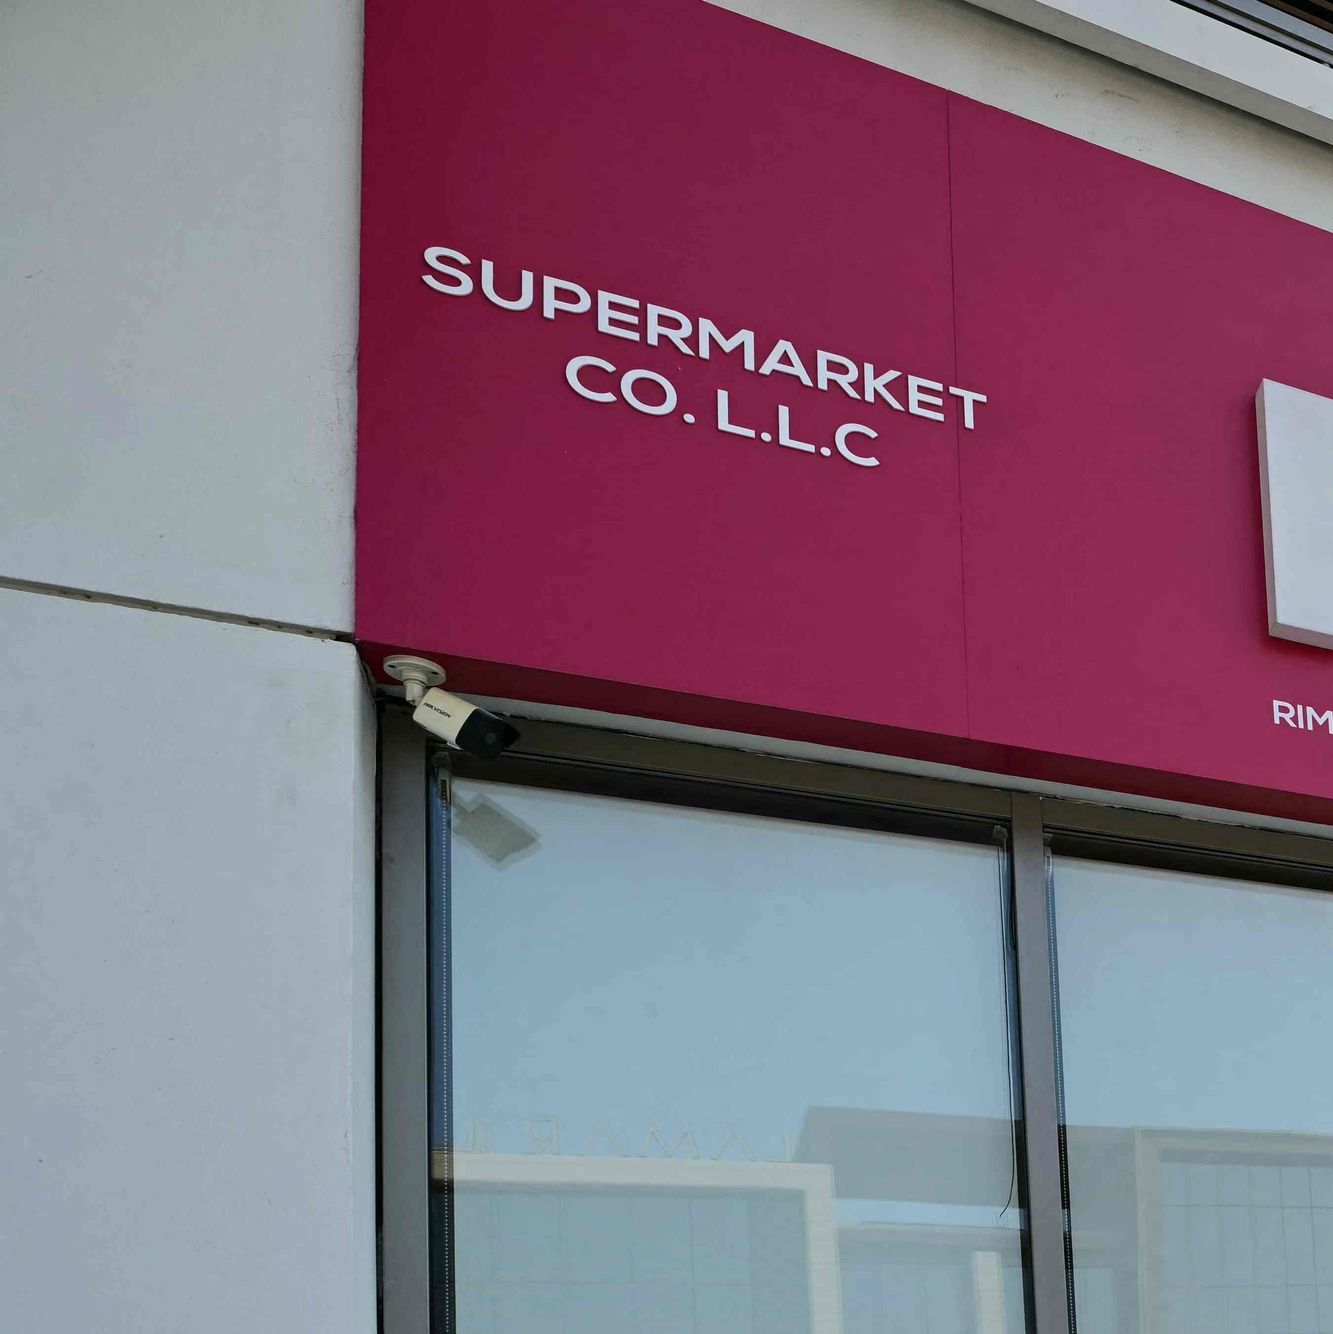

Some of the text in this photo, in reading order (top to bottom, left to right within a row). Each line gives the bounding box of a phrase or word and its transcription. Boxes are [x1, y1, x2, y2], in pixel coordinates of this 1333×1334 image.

[421, 246, 988, 430] SUPERMARKET
[565, 355, 880, 468] CO. L.L.C
